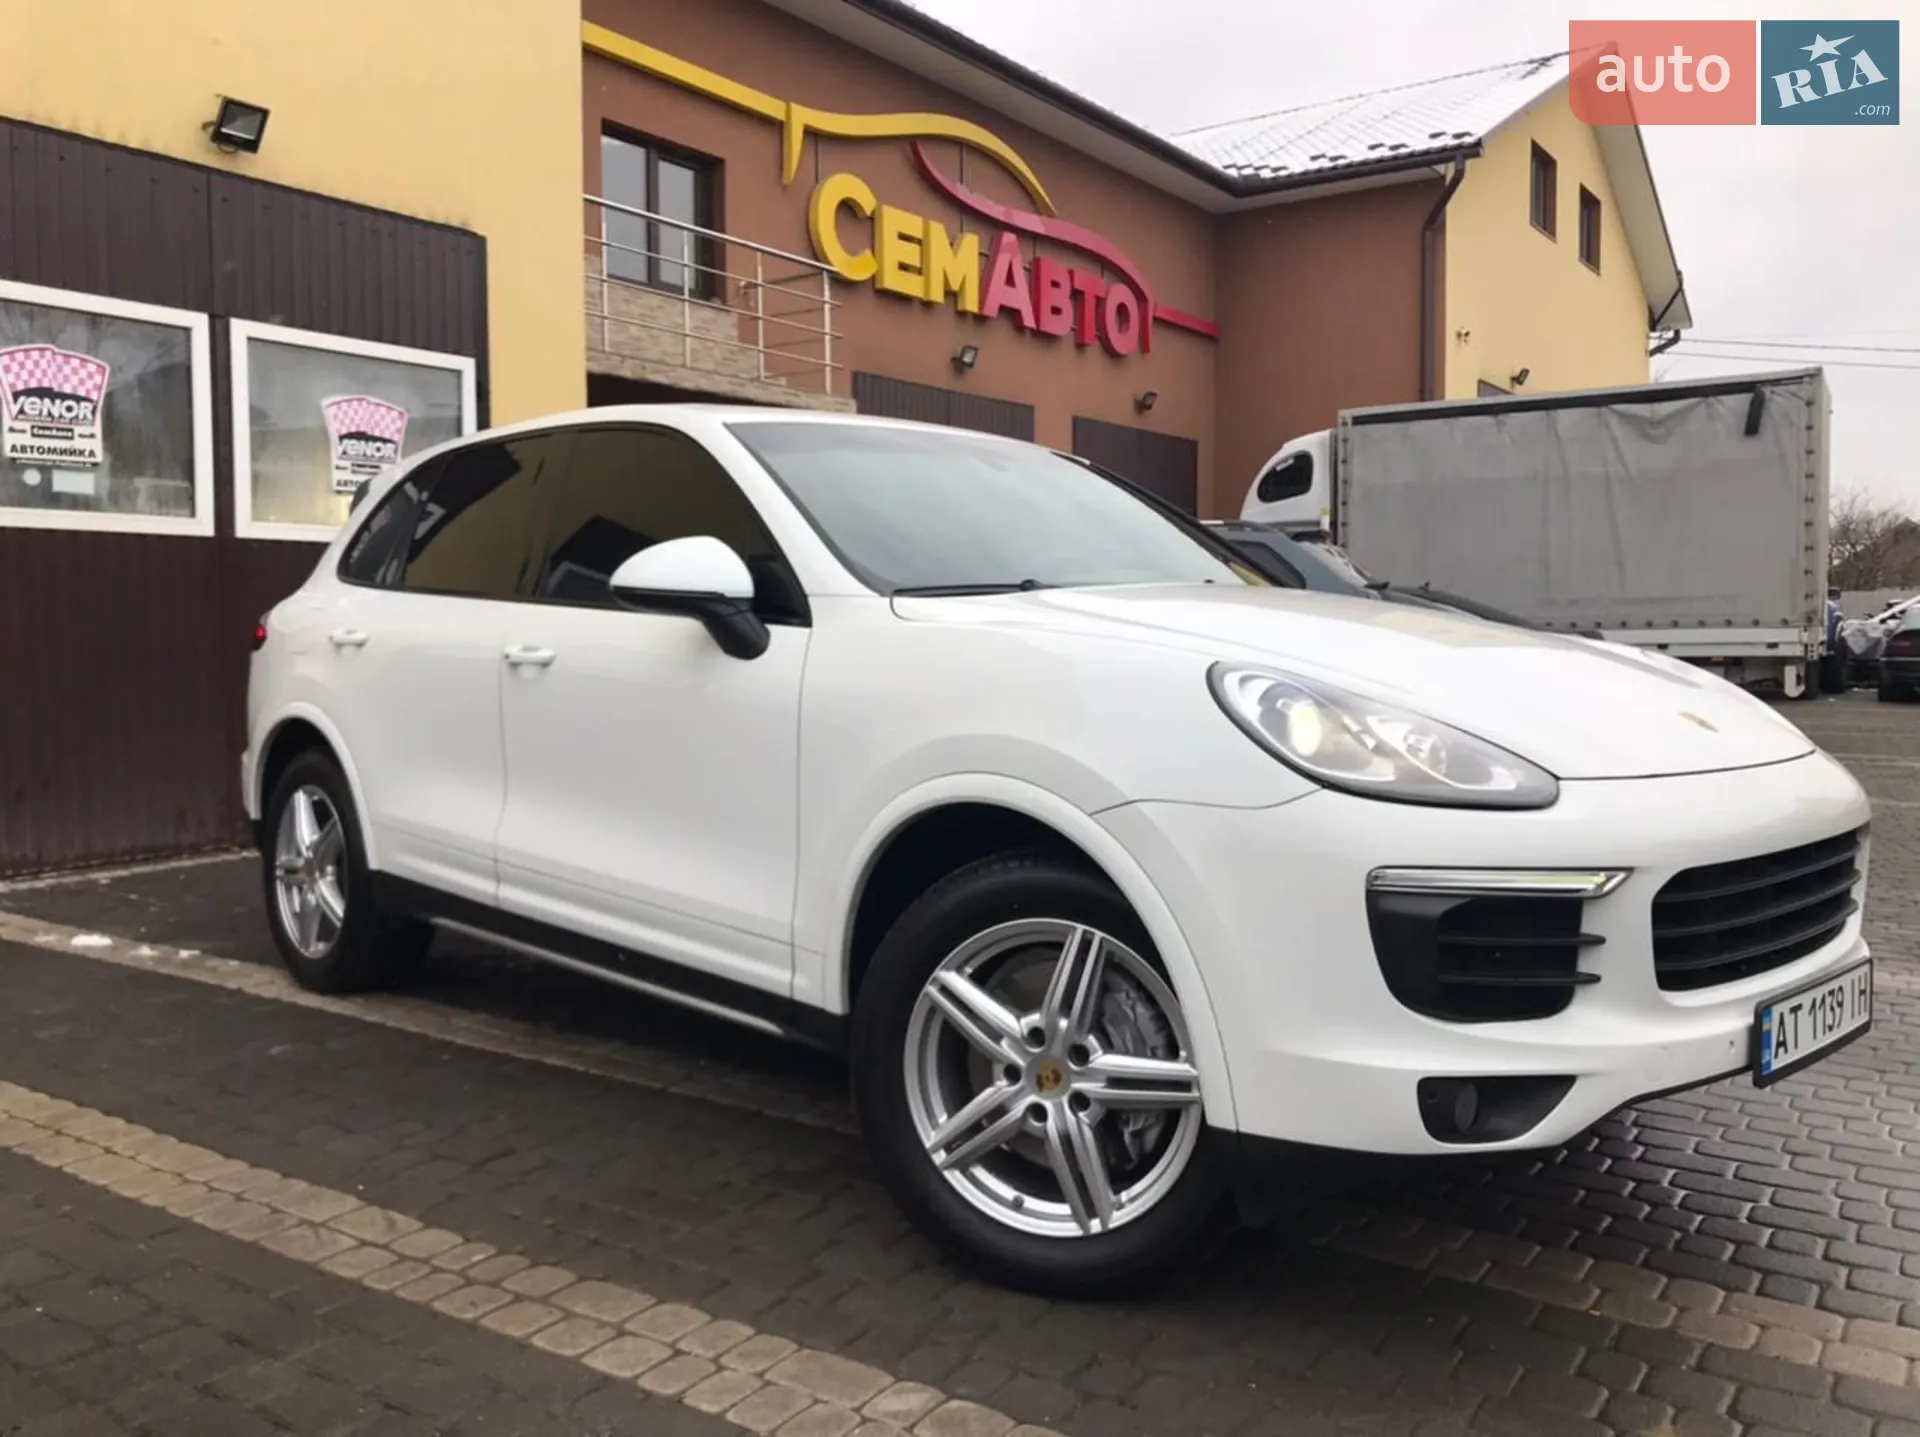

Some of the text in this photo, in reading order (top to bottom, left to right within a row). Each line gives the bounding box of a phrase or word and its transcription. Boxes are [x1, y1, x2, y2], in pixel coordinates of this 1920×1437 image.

[10, 443, 97, 458] АВТОМИЙКА
[1774, 972, 1868, 1059] AT 1139 IH
